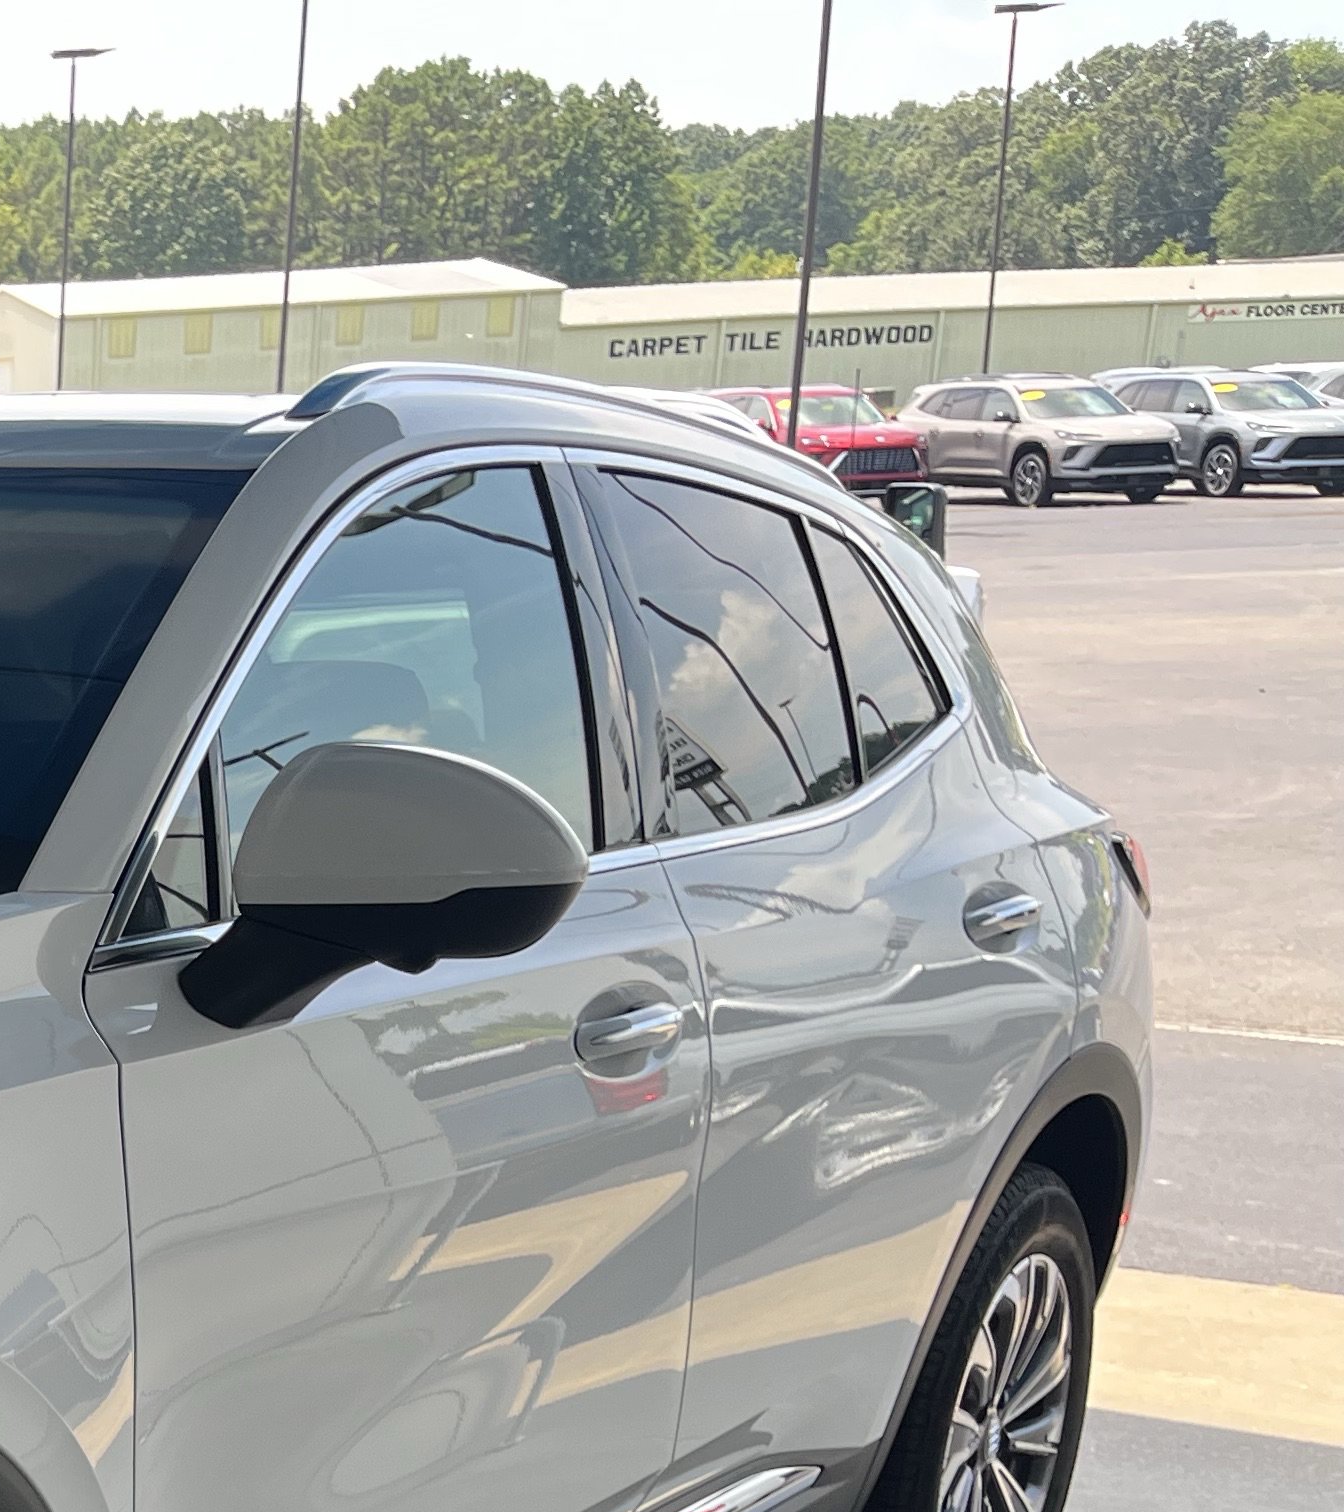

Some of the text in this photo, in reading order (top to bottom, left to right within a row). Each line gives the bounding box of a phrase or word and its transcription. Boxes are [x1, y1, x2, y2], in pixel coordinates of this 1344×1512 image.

[1246, 304, 1295, 317] FLOOR
[609, 325, 933, 358] CARPET TILE HARDWOOD
